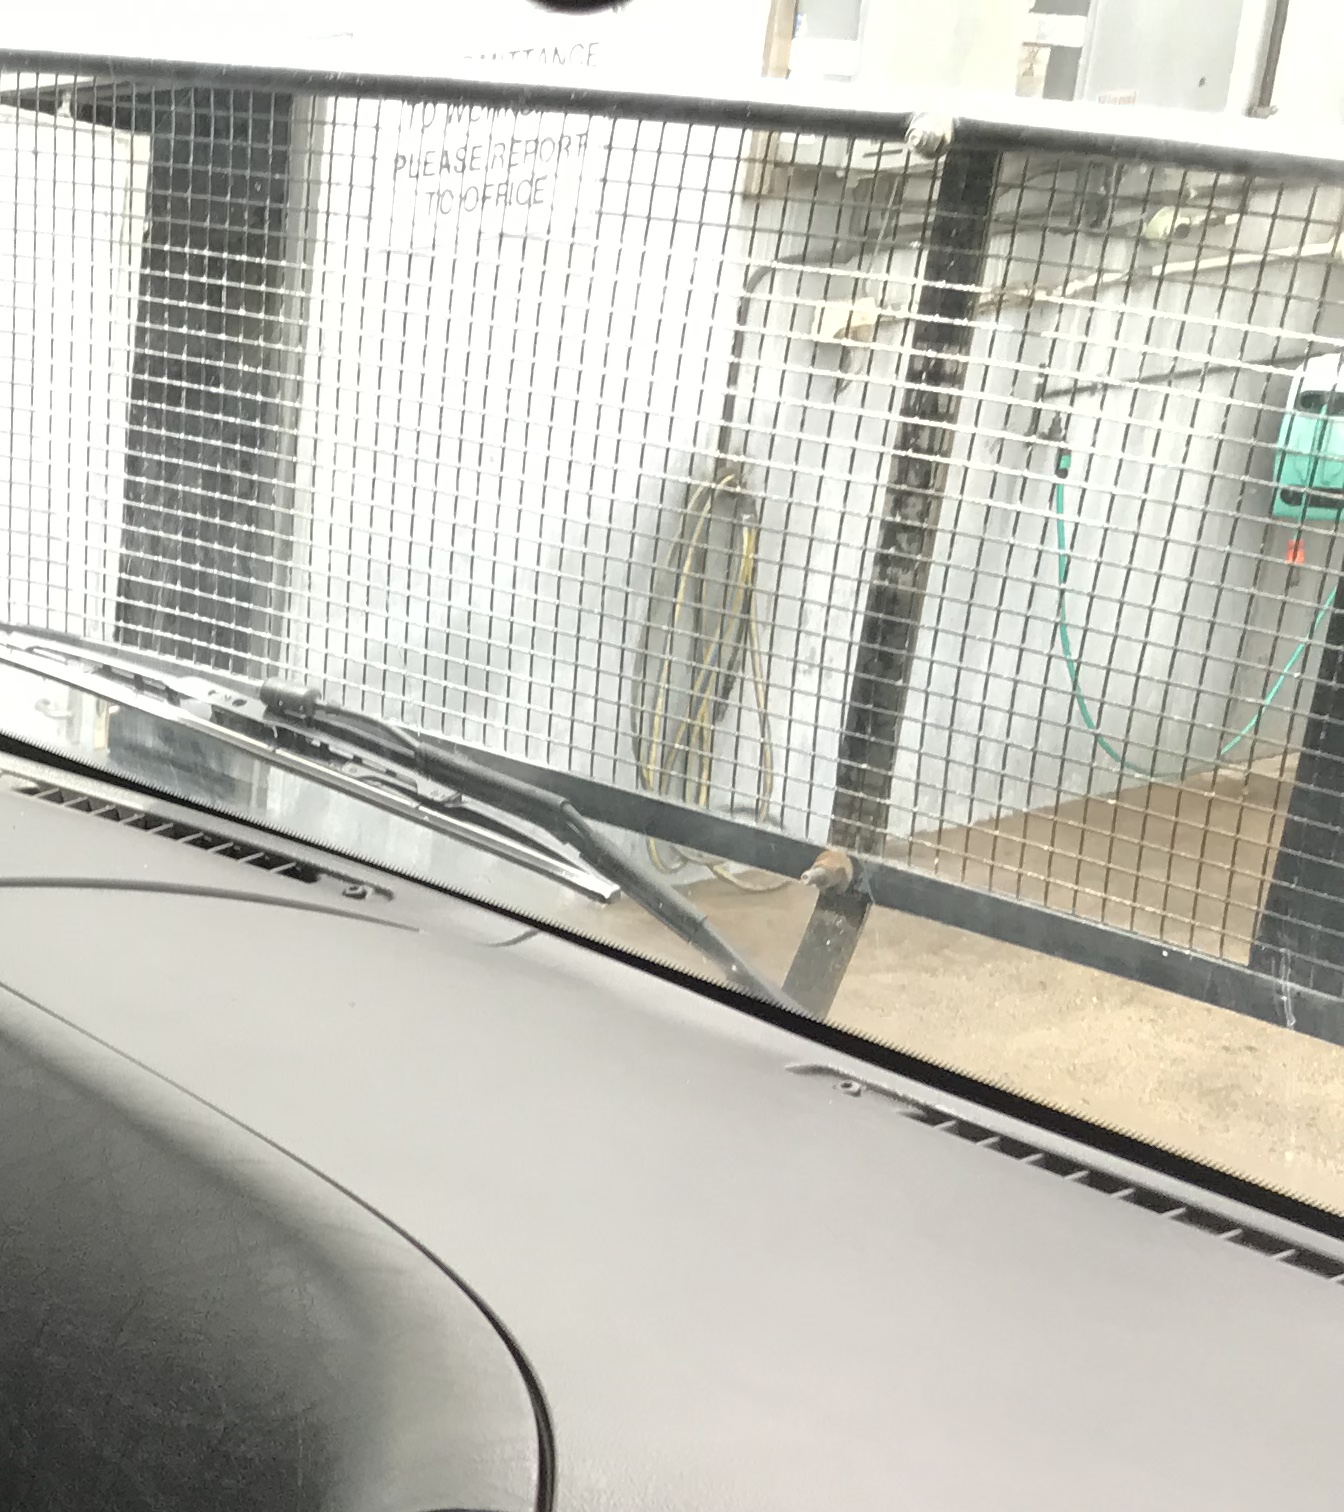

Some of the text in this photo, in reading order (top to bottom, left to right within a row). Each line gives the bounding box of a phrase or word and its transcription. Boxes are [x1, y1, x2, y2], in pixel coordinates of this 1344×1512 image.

[393, 132, 589, 181] PLEASE REPORT
[425, 174, 548, 215] TO OFFICE
